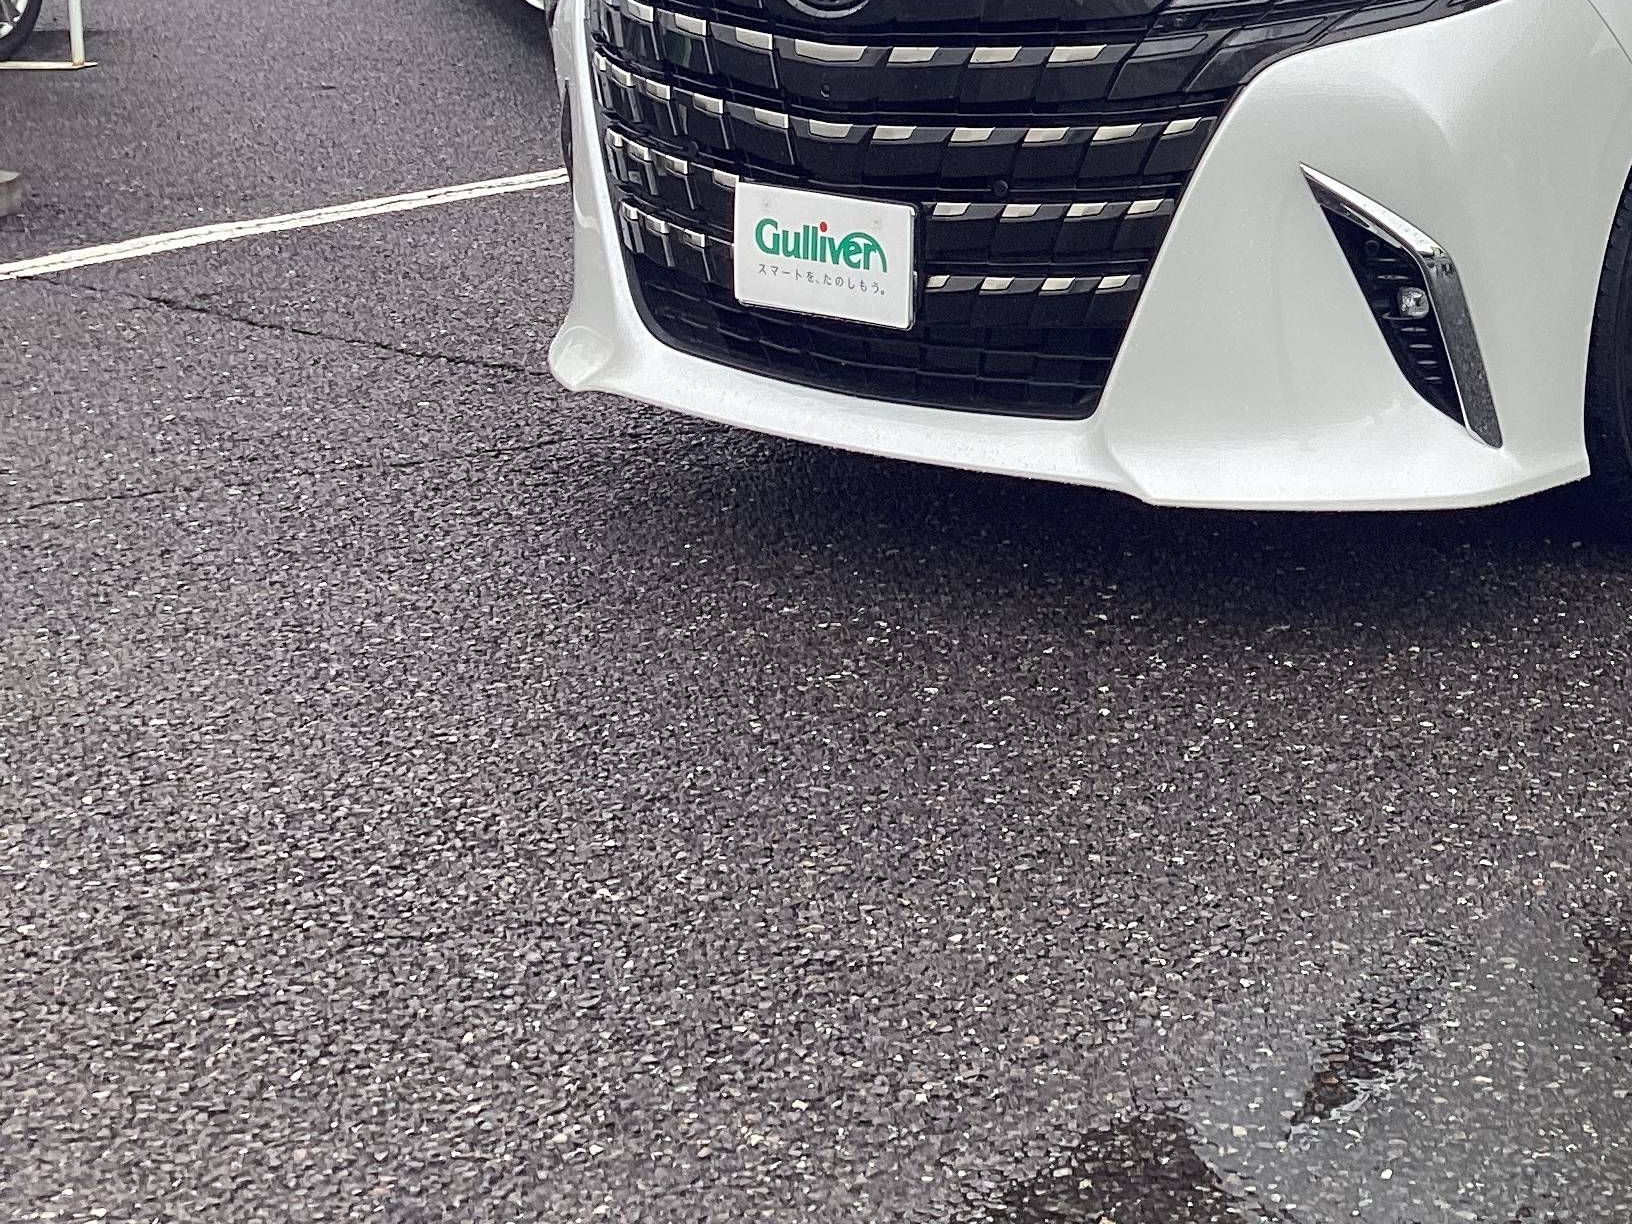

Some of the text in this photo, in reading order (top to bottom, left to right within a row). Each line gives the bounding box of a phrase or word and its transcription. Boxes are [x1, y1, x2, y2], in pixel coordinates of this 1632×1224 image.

[755, 218, 887, 273] Gulliver
[758, 263, 885, 295] スマートを、たのしもう。
